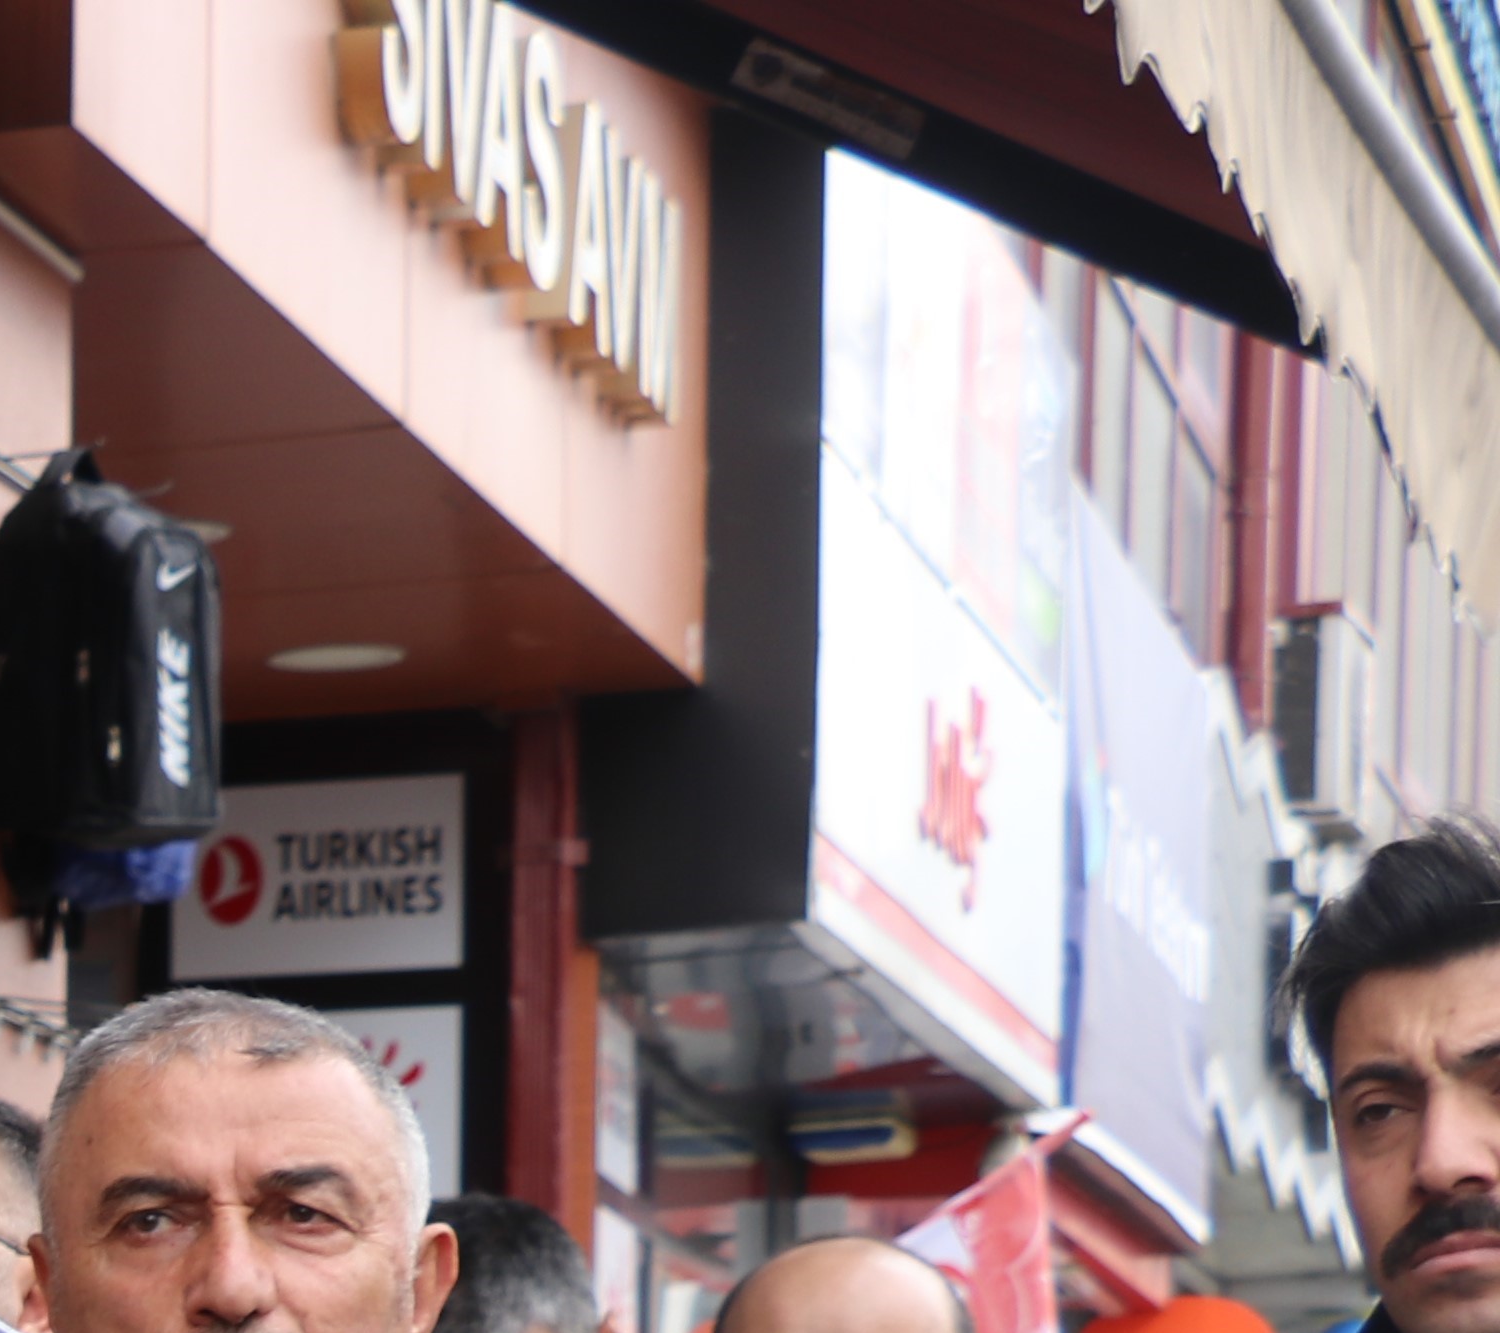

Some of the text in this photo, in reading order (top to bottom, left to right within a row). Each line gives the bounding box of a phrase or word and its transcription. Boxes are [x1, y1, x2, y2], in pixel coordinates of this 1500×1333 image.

[568, 100, 683, 428] AVM
[156, 627, 191, 789] NIKE
[271, 874, 444, 923] AIRLINES
[276, 826, 443, 872] TURKISH
